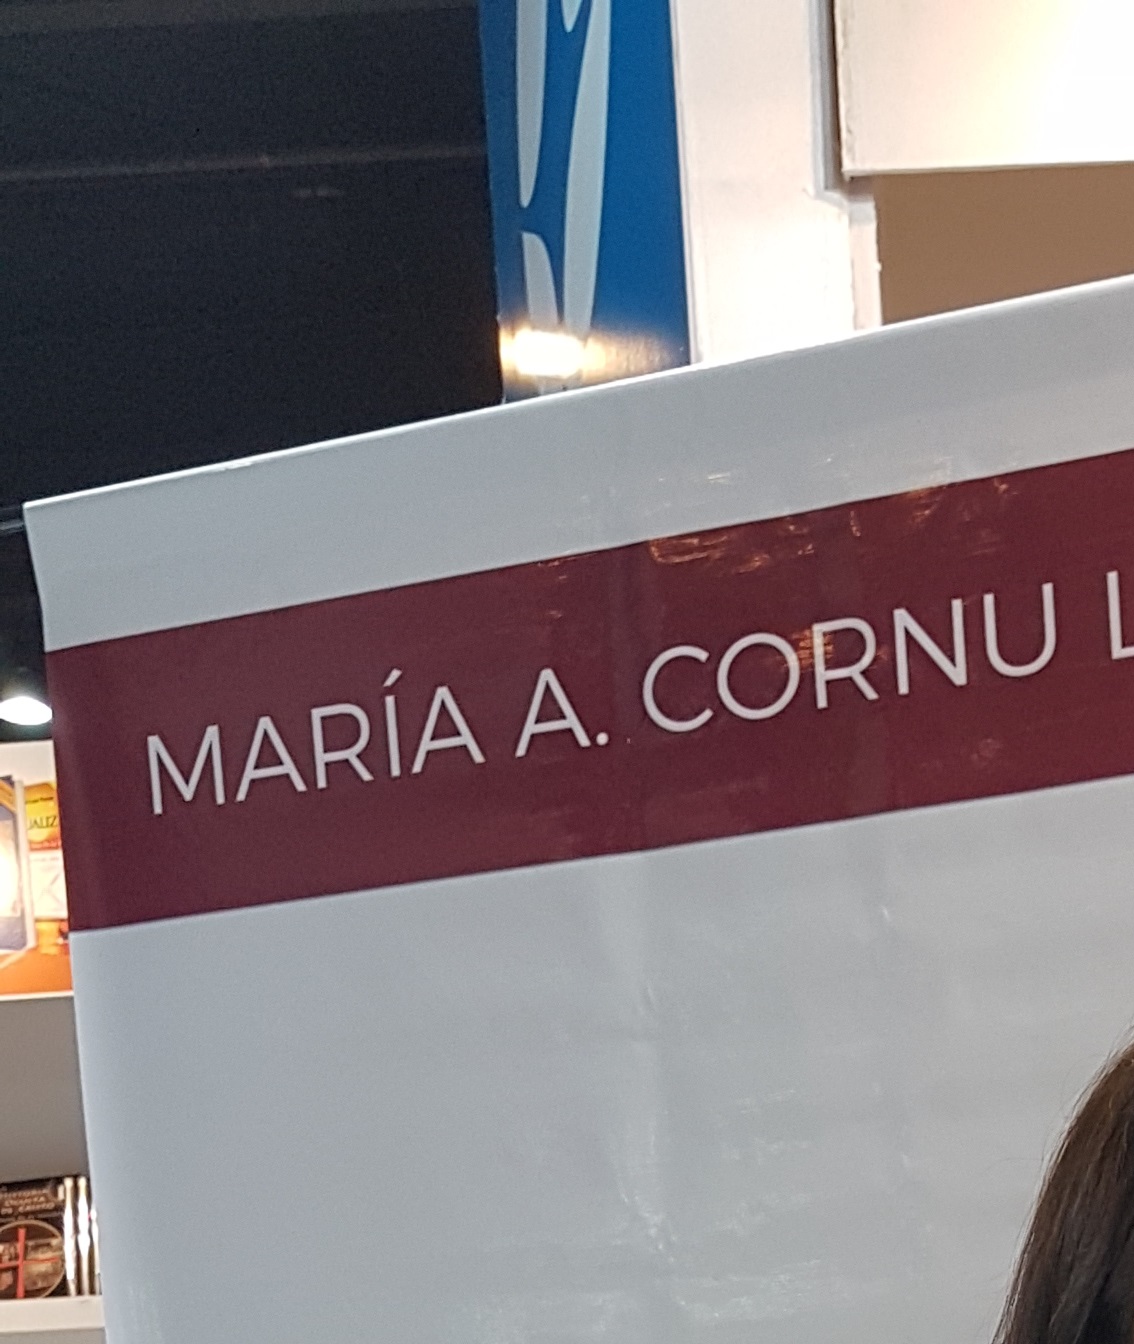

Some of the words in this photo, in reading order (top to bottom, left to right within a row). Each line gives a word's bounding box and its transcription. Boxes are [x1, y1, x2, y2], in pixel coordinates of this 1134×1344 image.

[146, 668, 486, 815] MARÍA
[515, 667, 609, 758] A.
[642, 582, 1058, 733] CORNU
